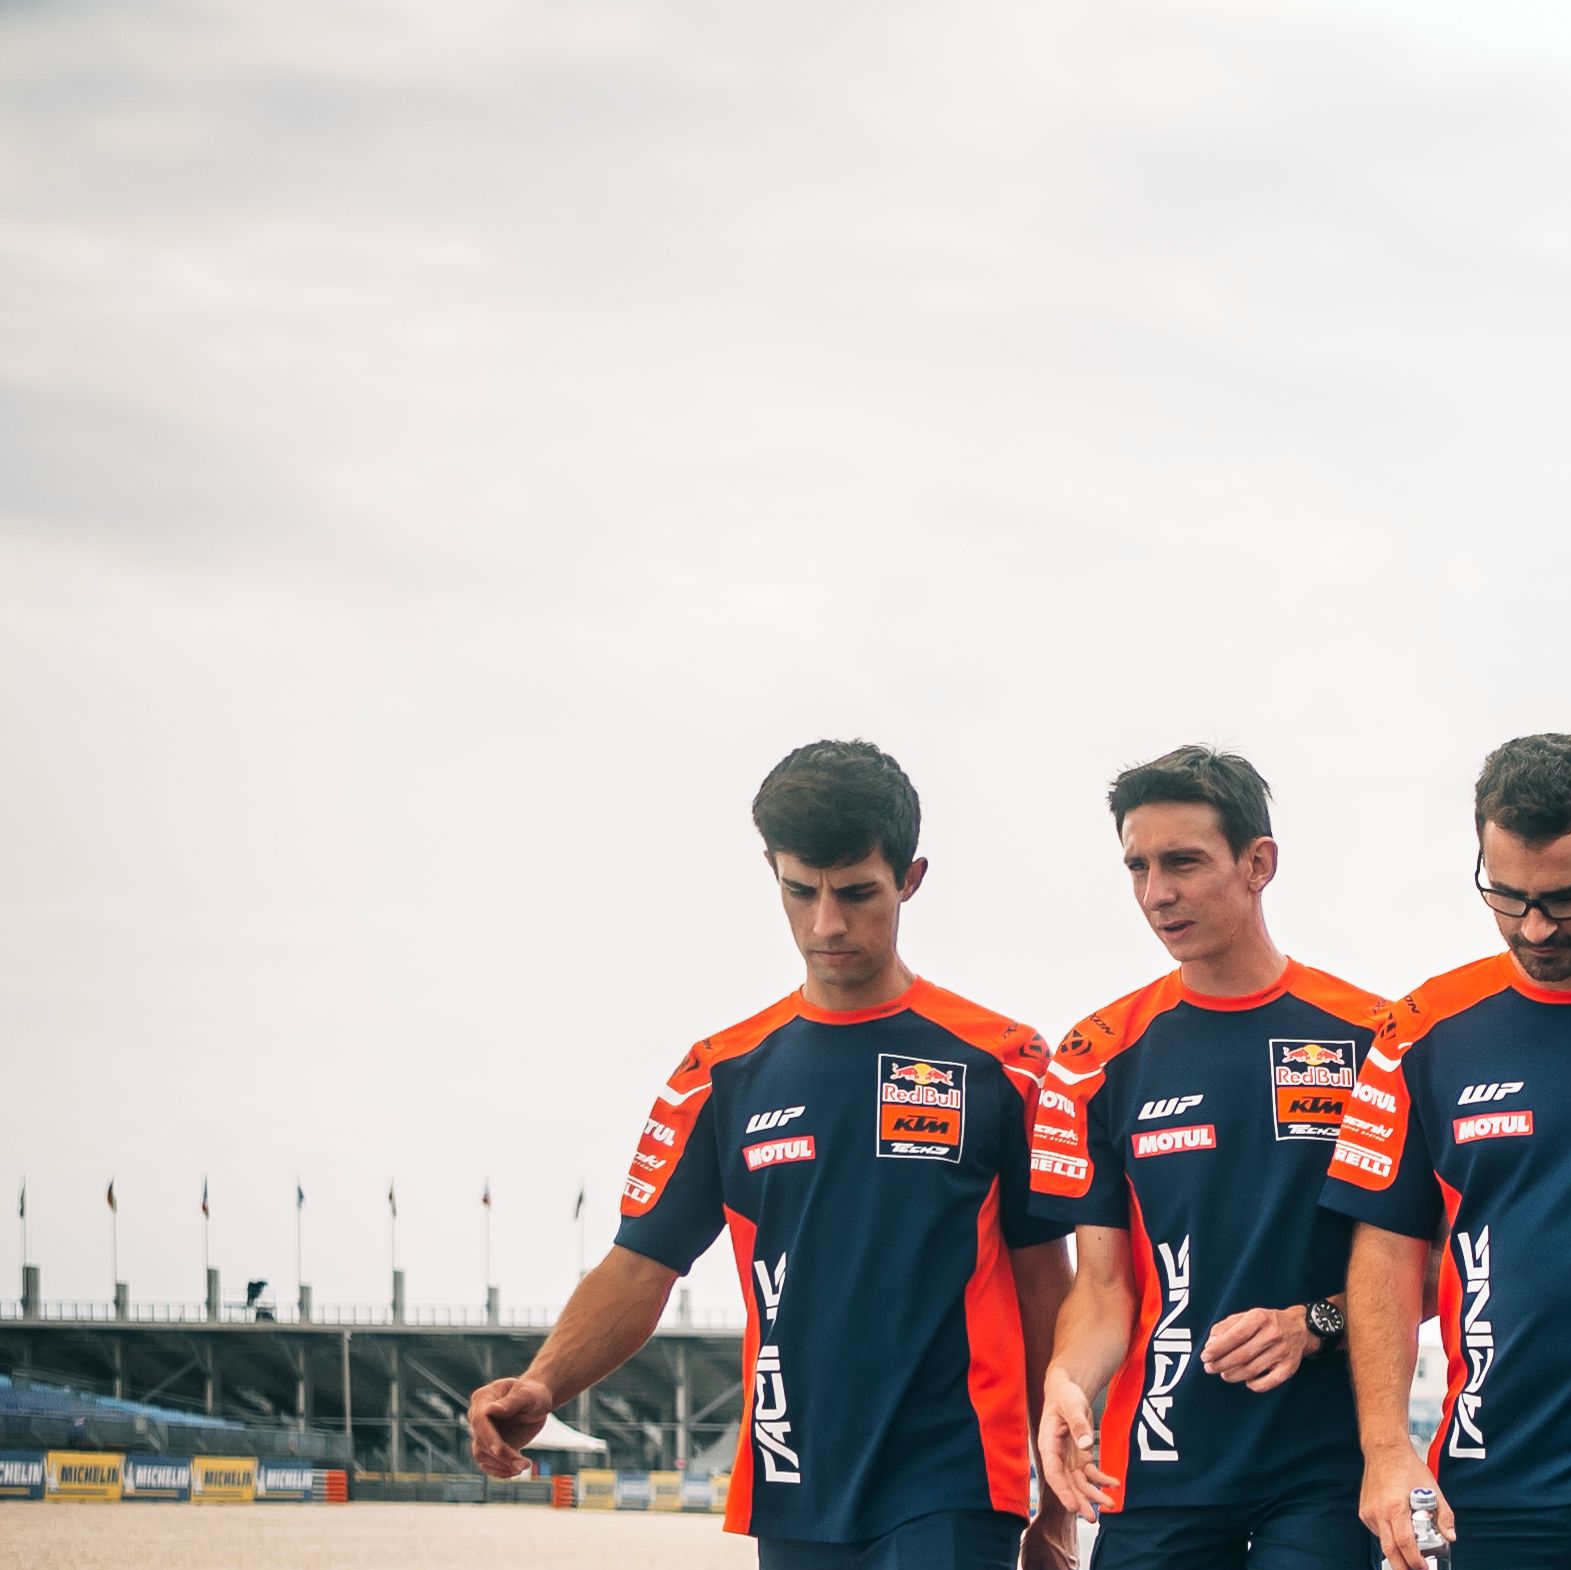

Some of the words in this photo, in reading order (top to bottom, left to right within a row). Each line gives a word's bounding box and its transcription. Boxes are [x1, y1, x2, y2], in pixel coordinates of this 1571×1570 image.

[1276, 1066, 1314, 1086] Red
[1315, 1066, 1352, 1088] Bull
[882, 1084, 922, 1104] Red
[924, 1087, 960, 1109] Bull
[1288, 1096, 1343, 1116] KTM
[1457, 1081, 1524, 1106] WP
[745, 1105, 805, 1134] WP
[1137, 1094, 1204, 1120] WP
[643, 1119, 677, 1147] TUL
[892, 1115, 950, 1135] KTM
[1458, 1113, 1530, 1141] MOTUL
[748, 1139, 812, 1168] MOTUL
[1138, 1127, 1212, 1155] MOTUL
